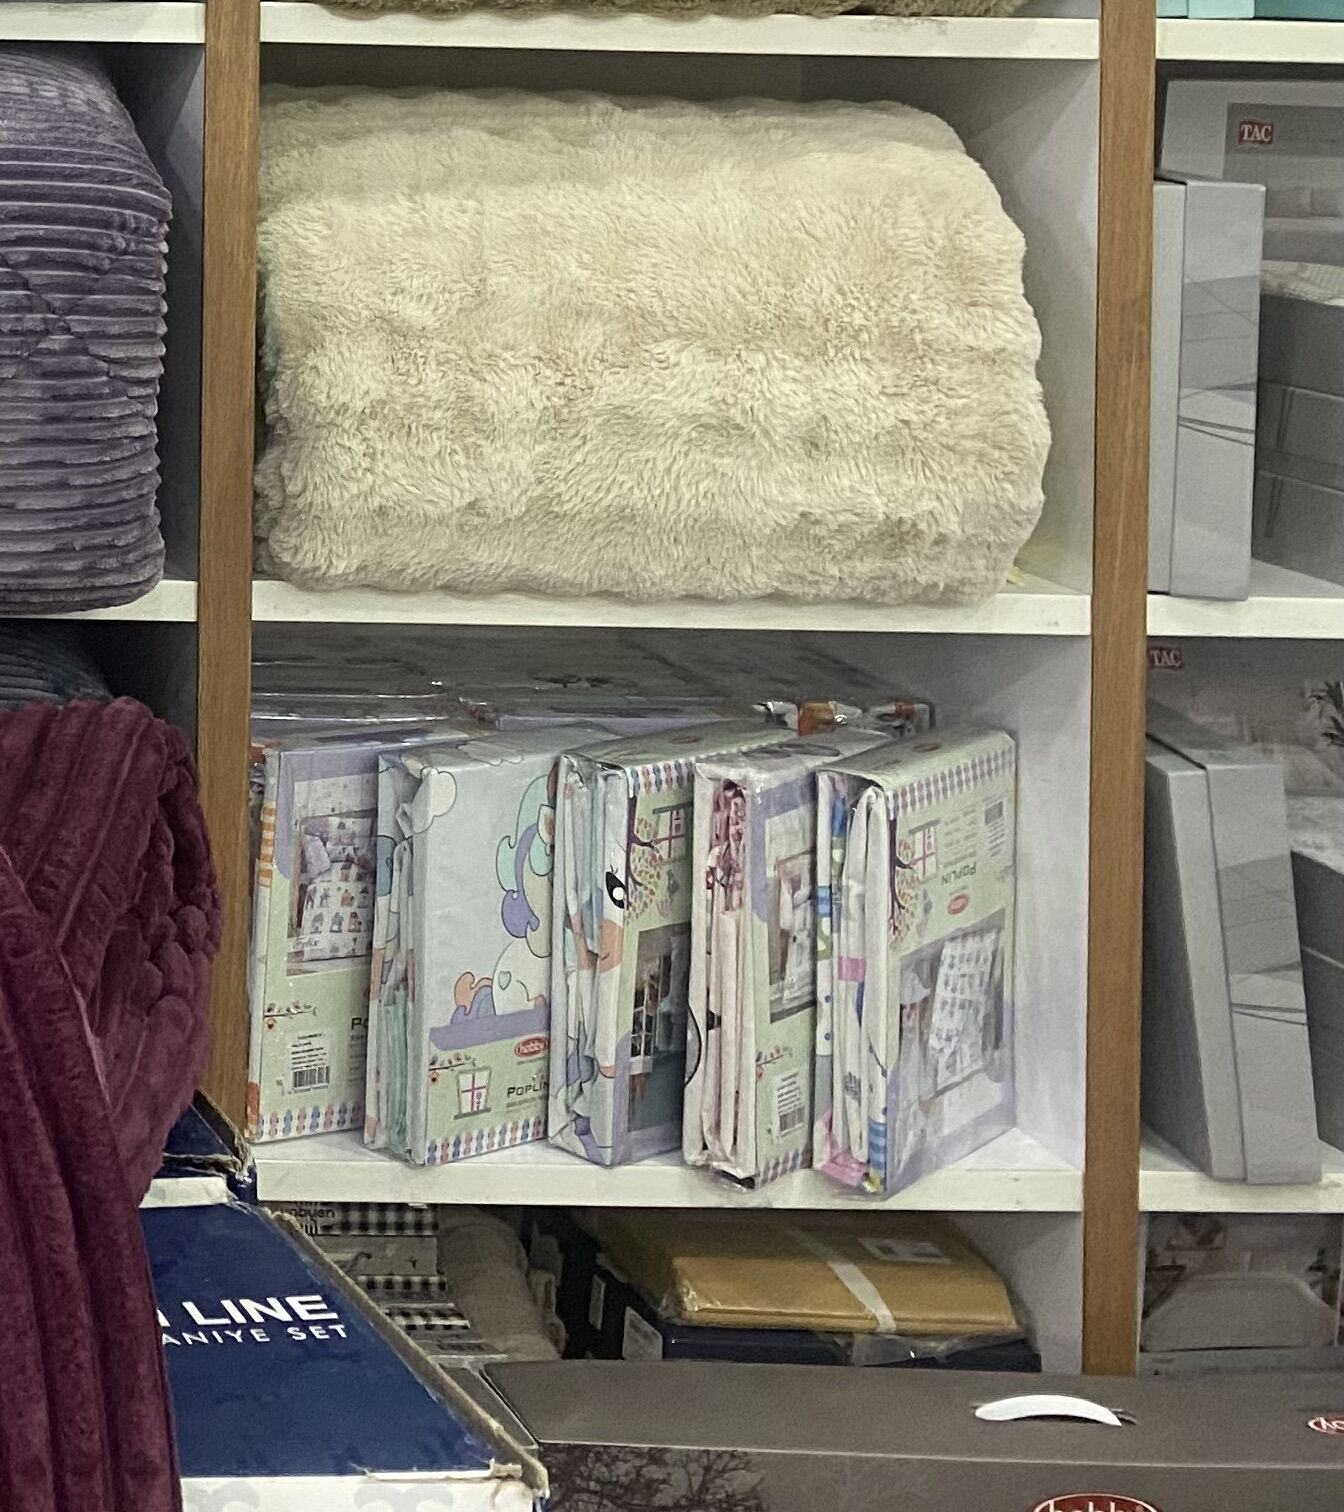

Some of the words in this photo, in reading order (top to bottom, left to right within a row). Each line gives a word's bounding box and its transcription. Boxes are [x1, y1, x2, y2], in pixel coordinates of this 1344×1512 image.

[181, 1294, 339, 1326] LINE
[163, 1329, 271, 1346] ANIYE
[286, 1325, 347, 1341] SET
